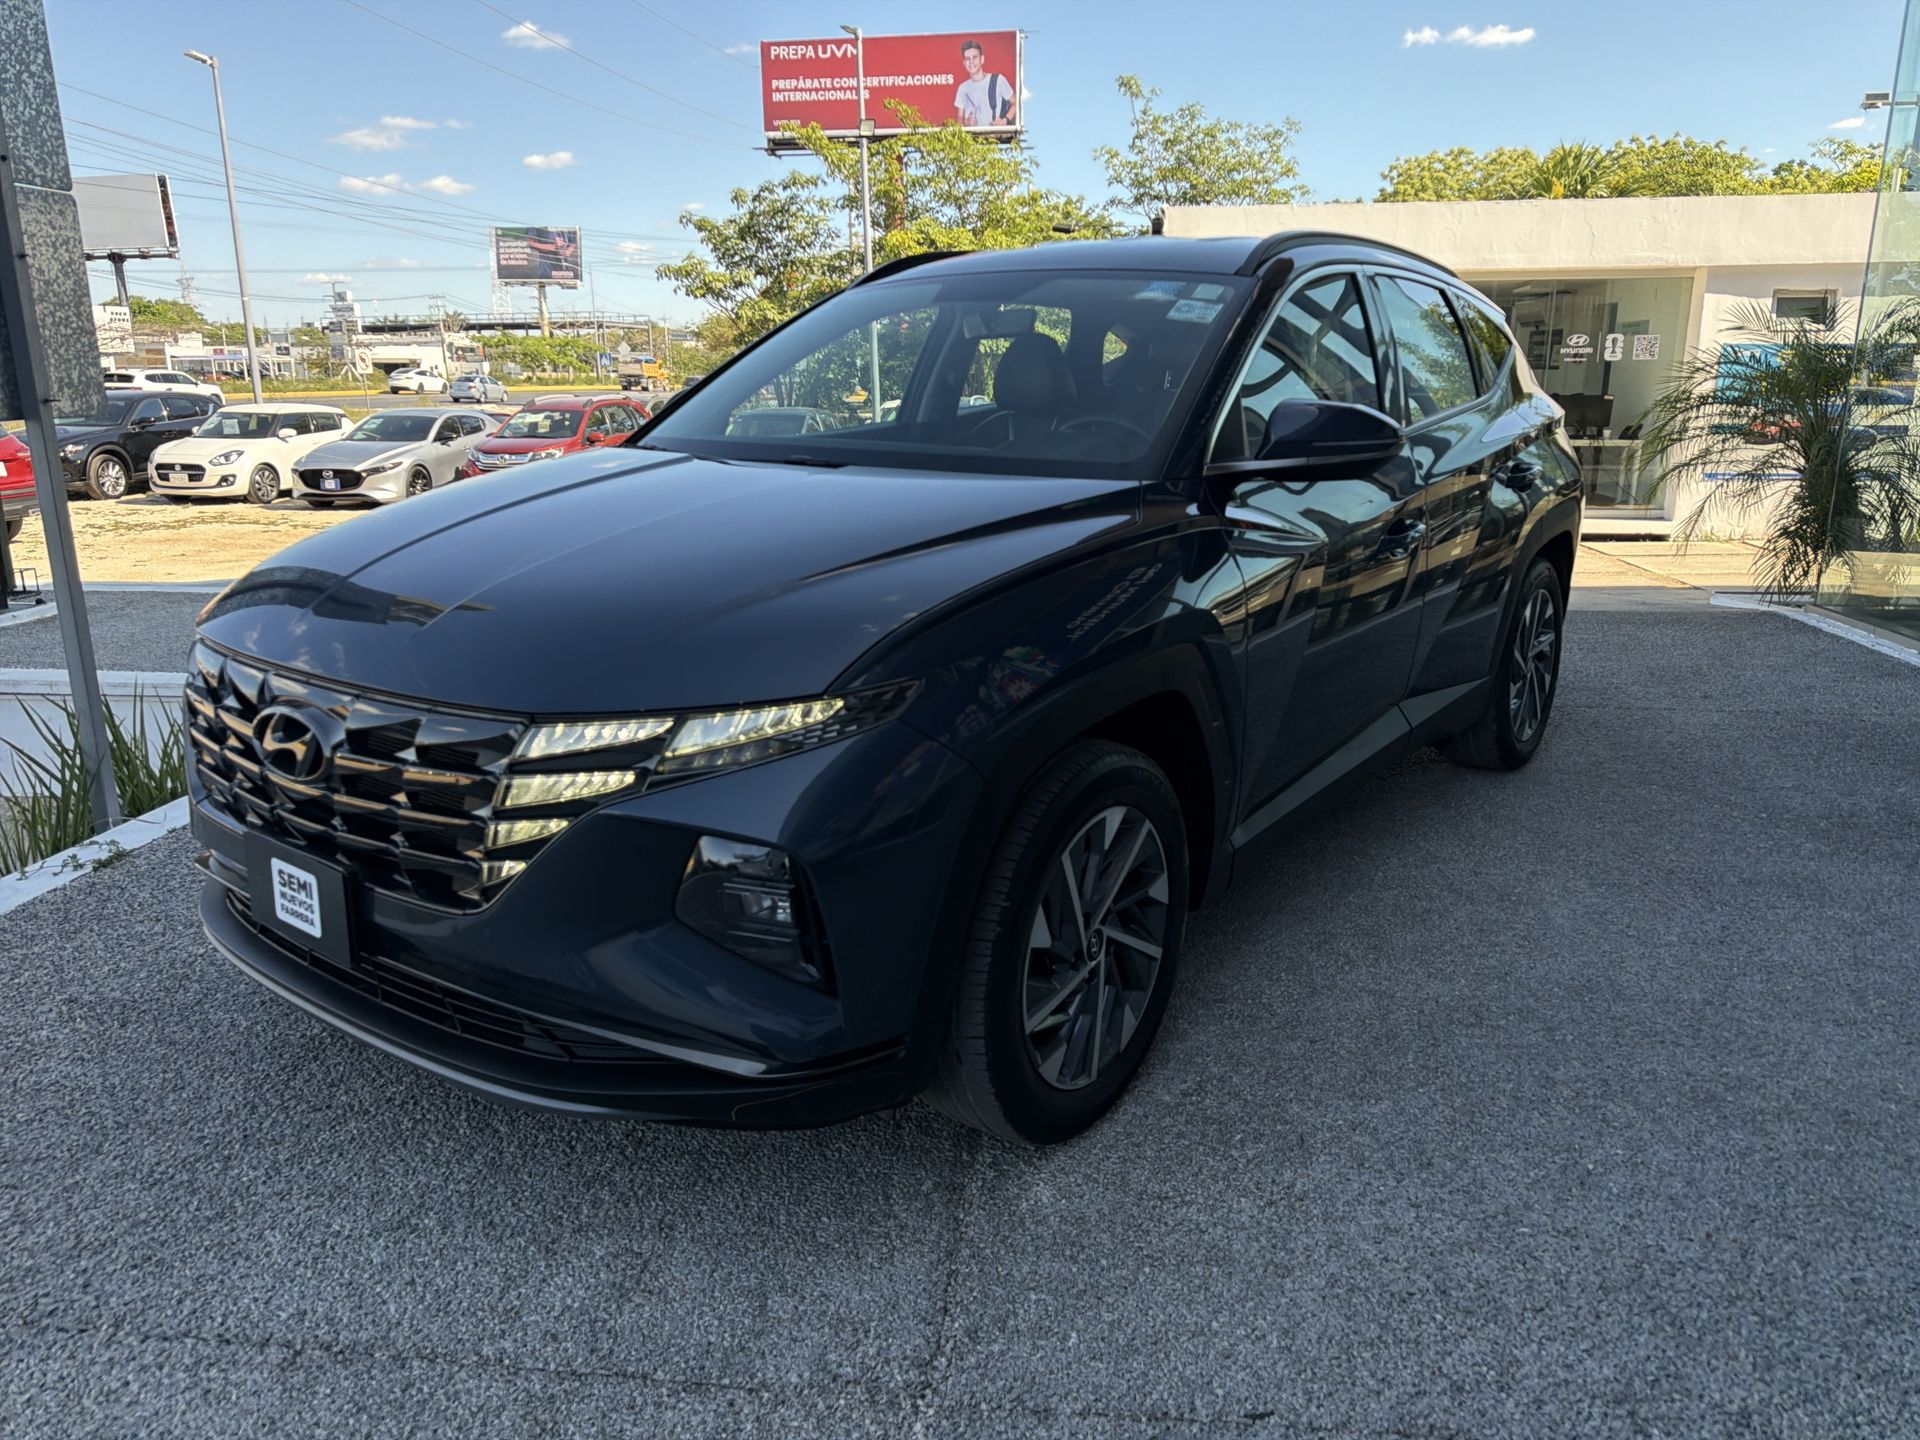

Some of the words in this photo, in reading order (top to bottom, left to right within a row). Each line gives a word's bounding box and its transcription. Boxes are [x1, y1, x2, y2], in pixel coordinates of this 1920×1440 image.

[770, 44, 816, 60] PREPA
[771, 75, 832, 91] PREPÁRATE
[833, 77, 858, 89] CON
[772, 89, 870, 102] INTERNACIONALS
[277, 868, 313, 901] SEMI
[279, 888, 315, 915] NUEVOS
